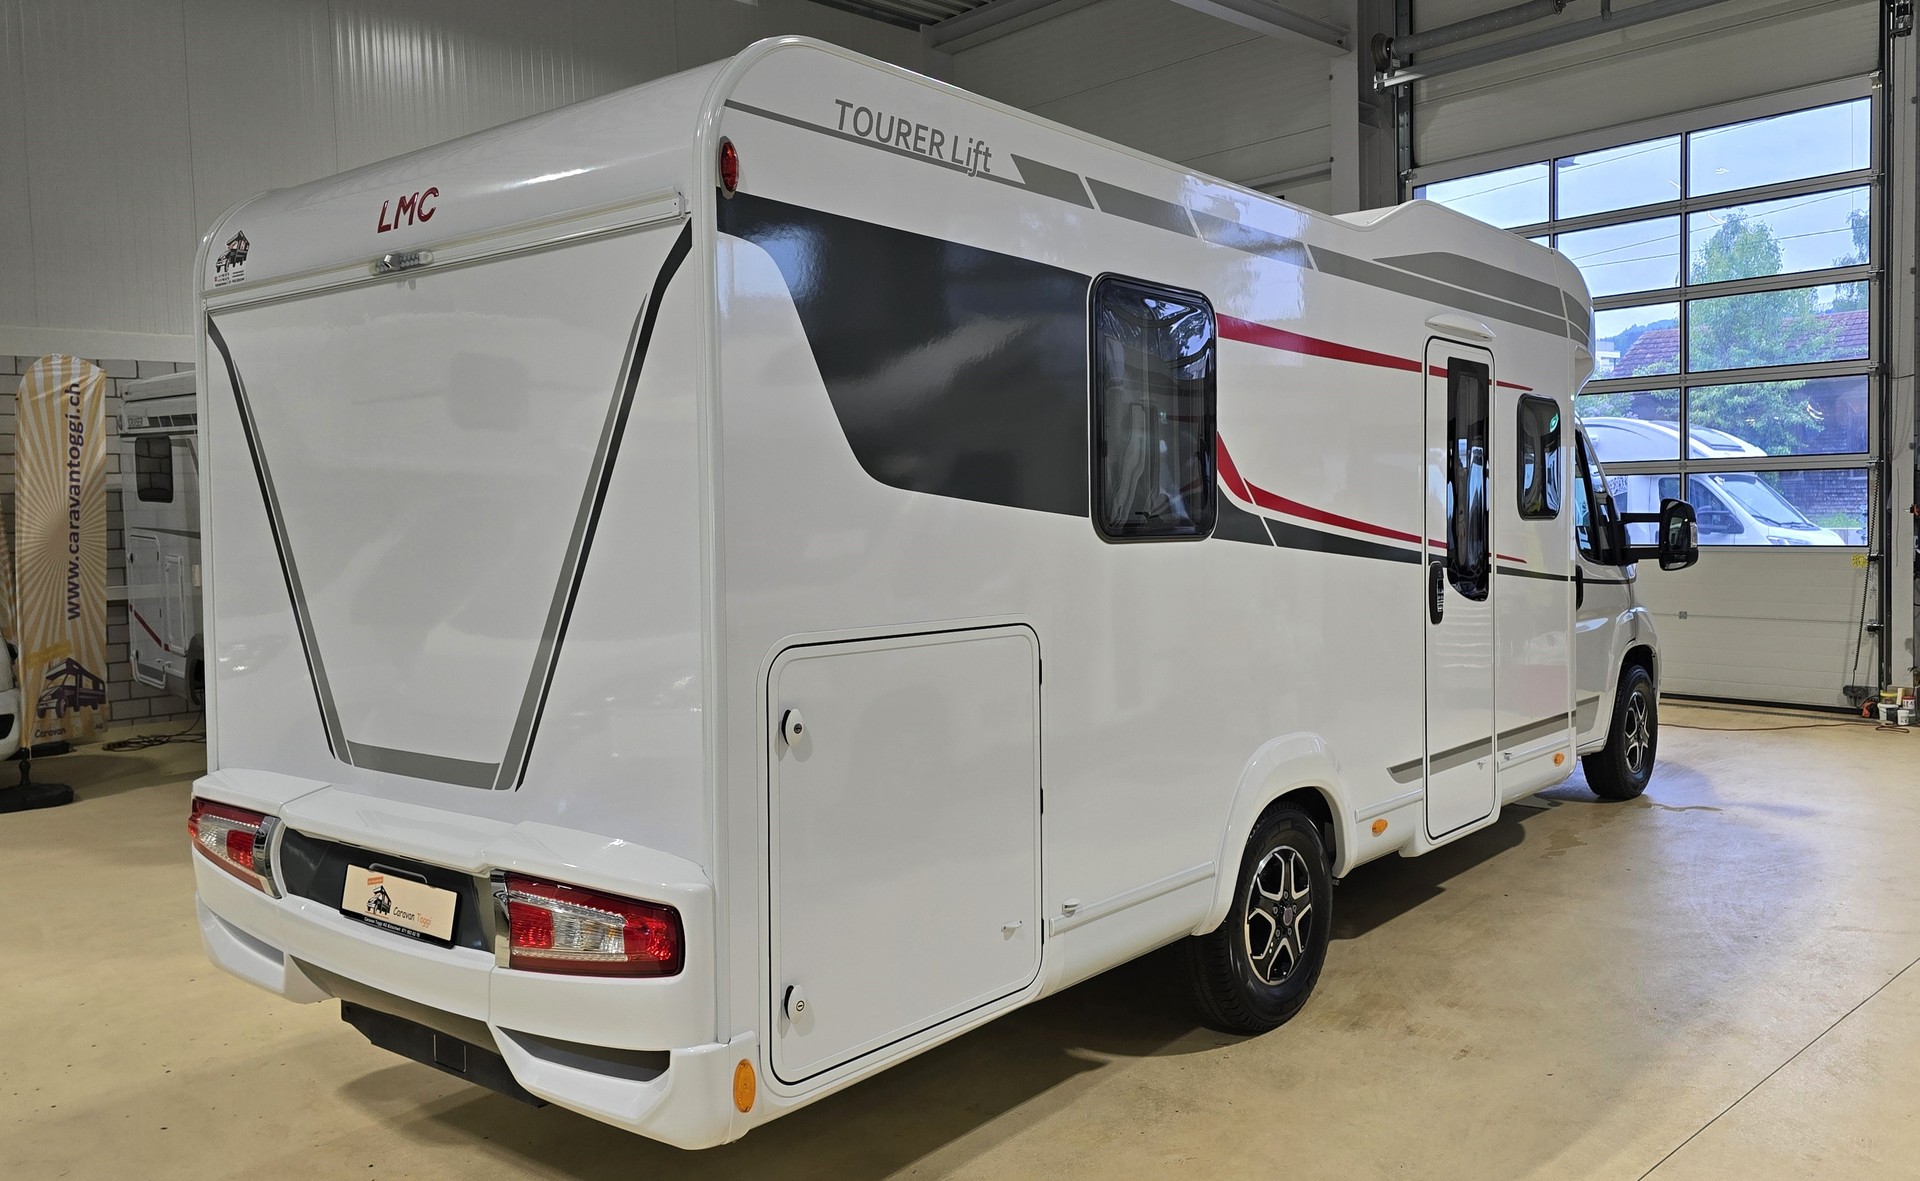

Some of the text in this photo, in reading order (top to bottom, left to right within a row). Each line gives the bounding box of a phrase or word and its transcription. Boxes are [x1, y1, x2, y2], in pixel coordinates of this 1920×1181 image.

[835, 99, 992, 177] TOURER Lift
[377, 187, 439, 233] LMC
[65, 383, 84, 621] www.caravantoggi.ch
[34, 727, 67, 739] Caravan
[393, 907, 432, 928] Caravan Toggi
